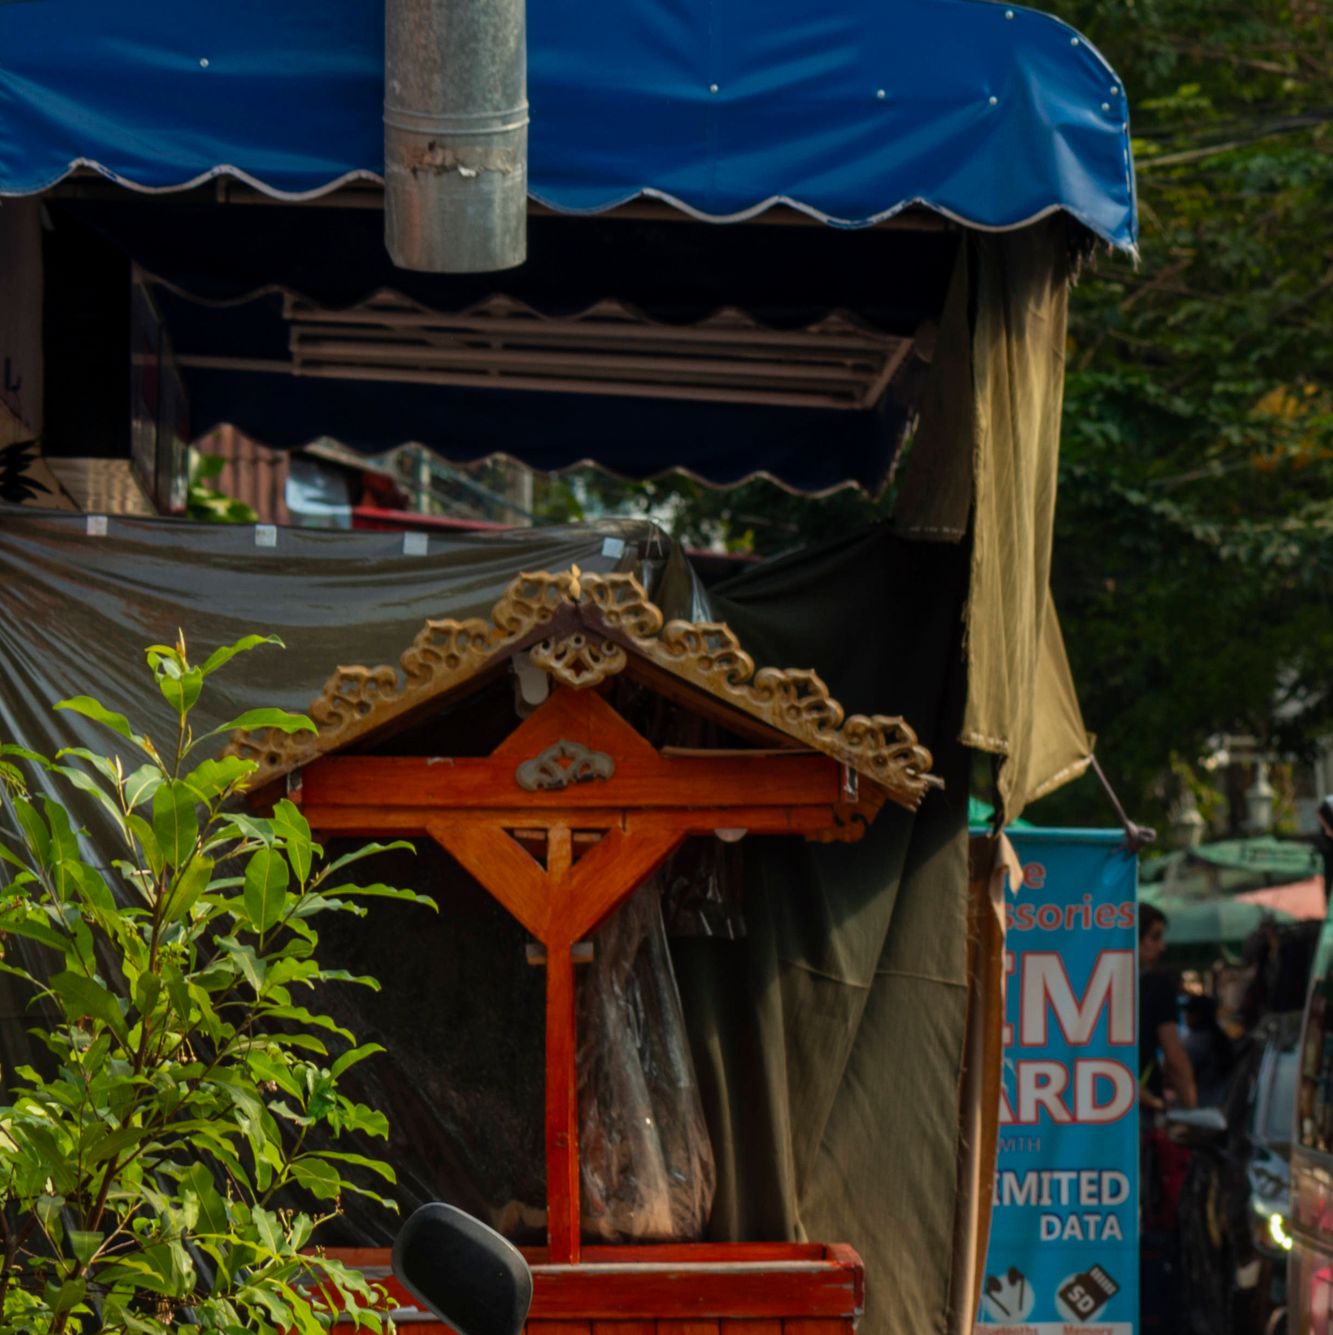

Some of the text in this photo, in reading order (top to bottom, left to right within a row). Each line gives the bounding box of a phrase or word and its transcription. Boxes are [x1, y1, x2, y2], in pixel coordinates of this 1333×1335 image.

[1005, 894, 1135, 930] ssories
[1040, 1213, 1123, 1241] DATA
[1067, 1285, 1095, 1313] SD
